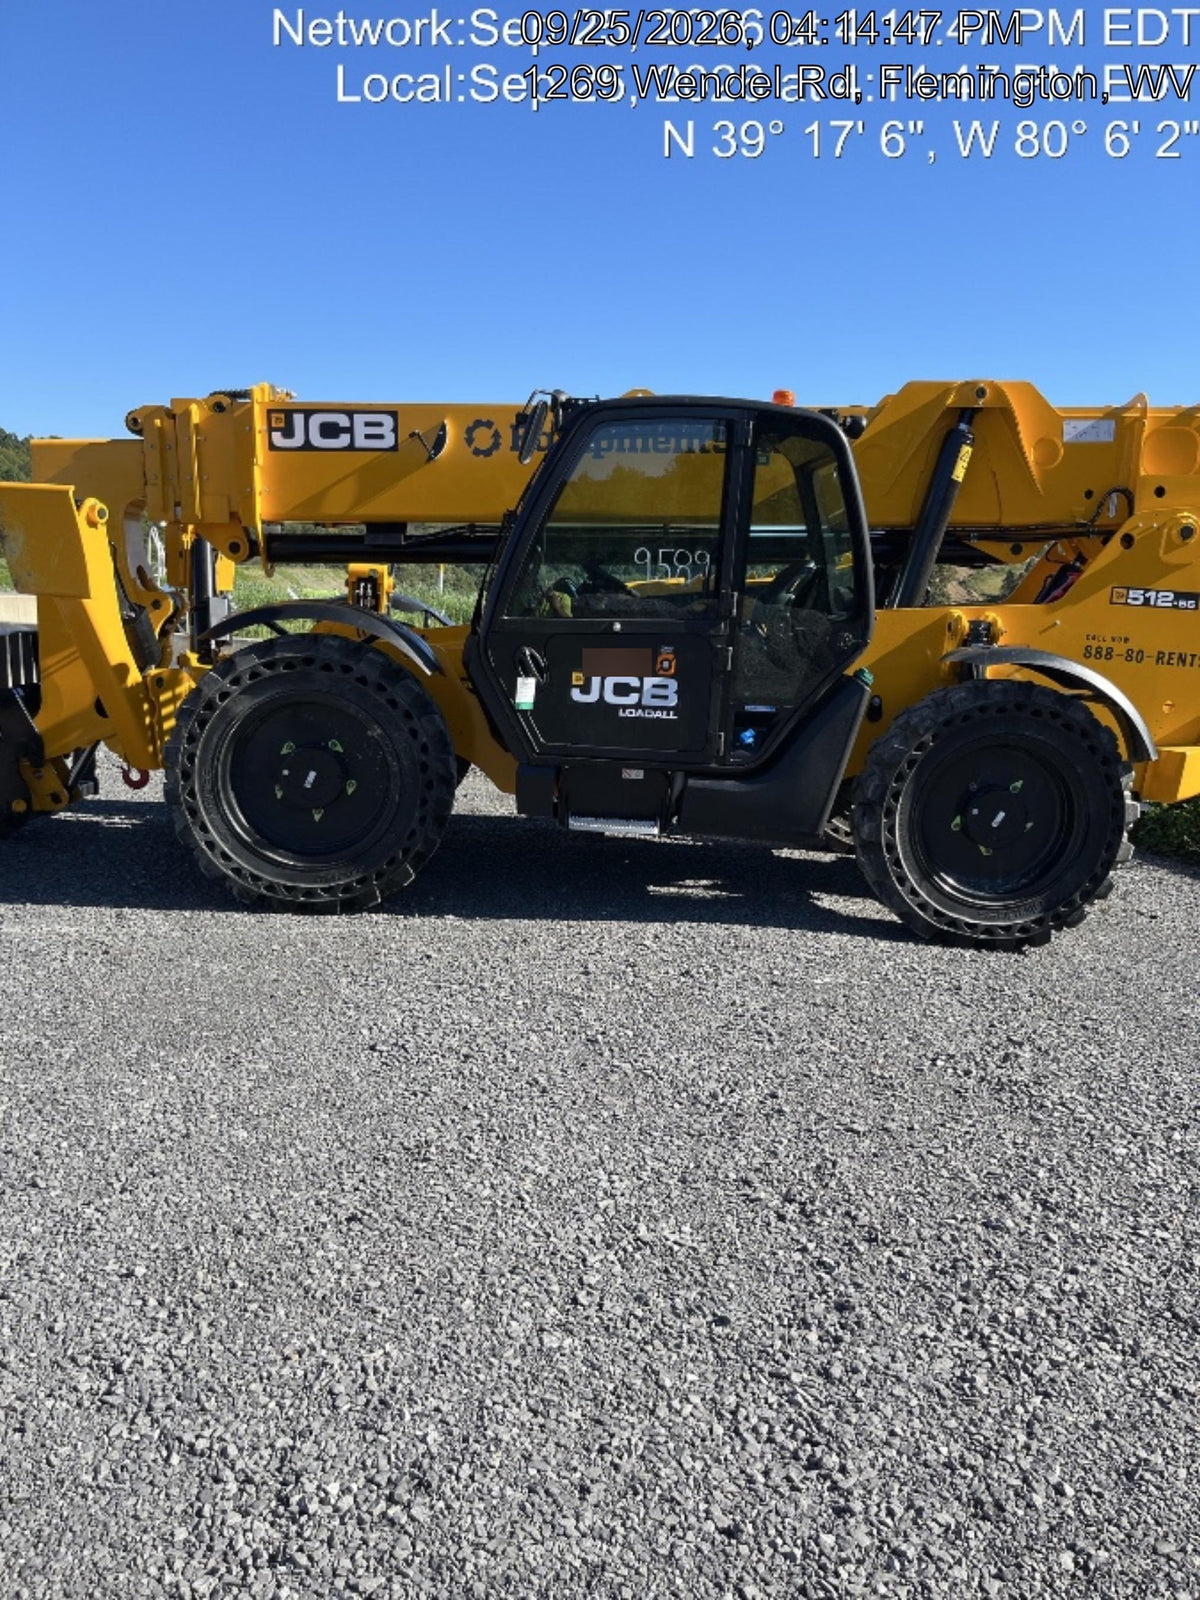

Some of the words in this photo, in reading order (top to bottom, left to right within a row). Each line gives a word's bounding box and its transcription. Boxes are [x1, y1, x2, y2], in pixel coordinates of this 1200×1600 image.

[271, 413, 396, 449] JCB
[634, 547, 711, 584] 9589
[1083, 645, 1200, 669] 888-80-RENT
[570, 676, 679, 707] JCB
[618, 708, 679, 720] LOADALL
